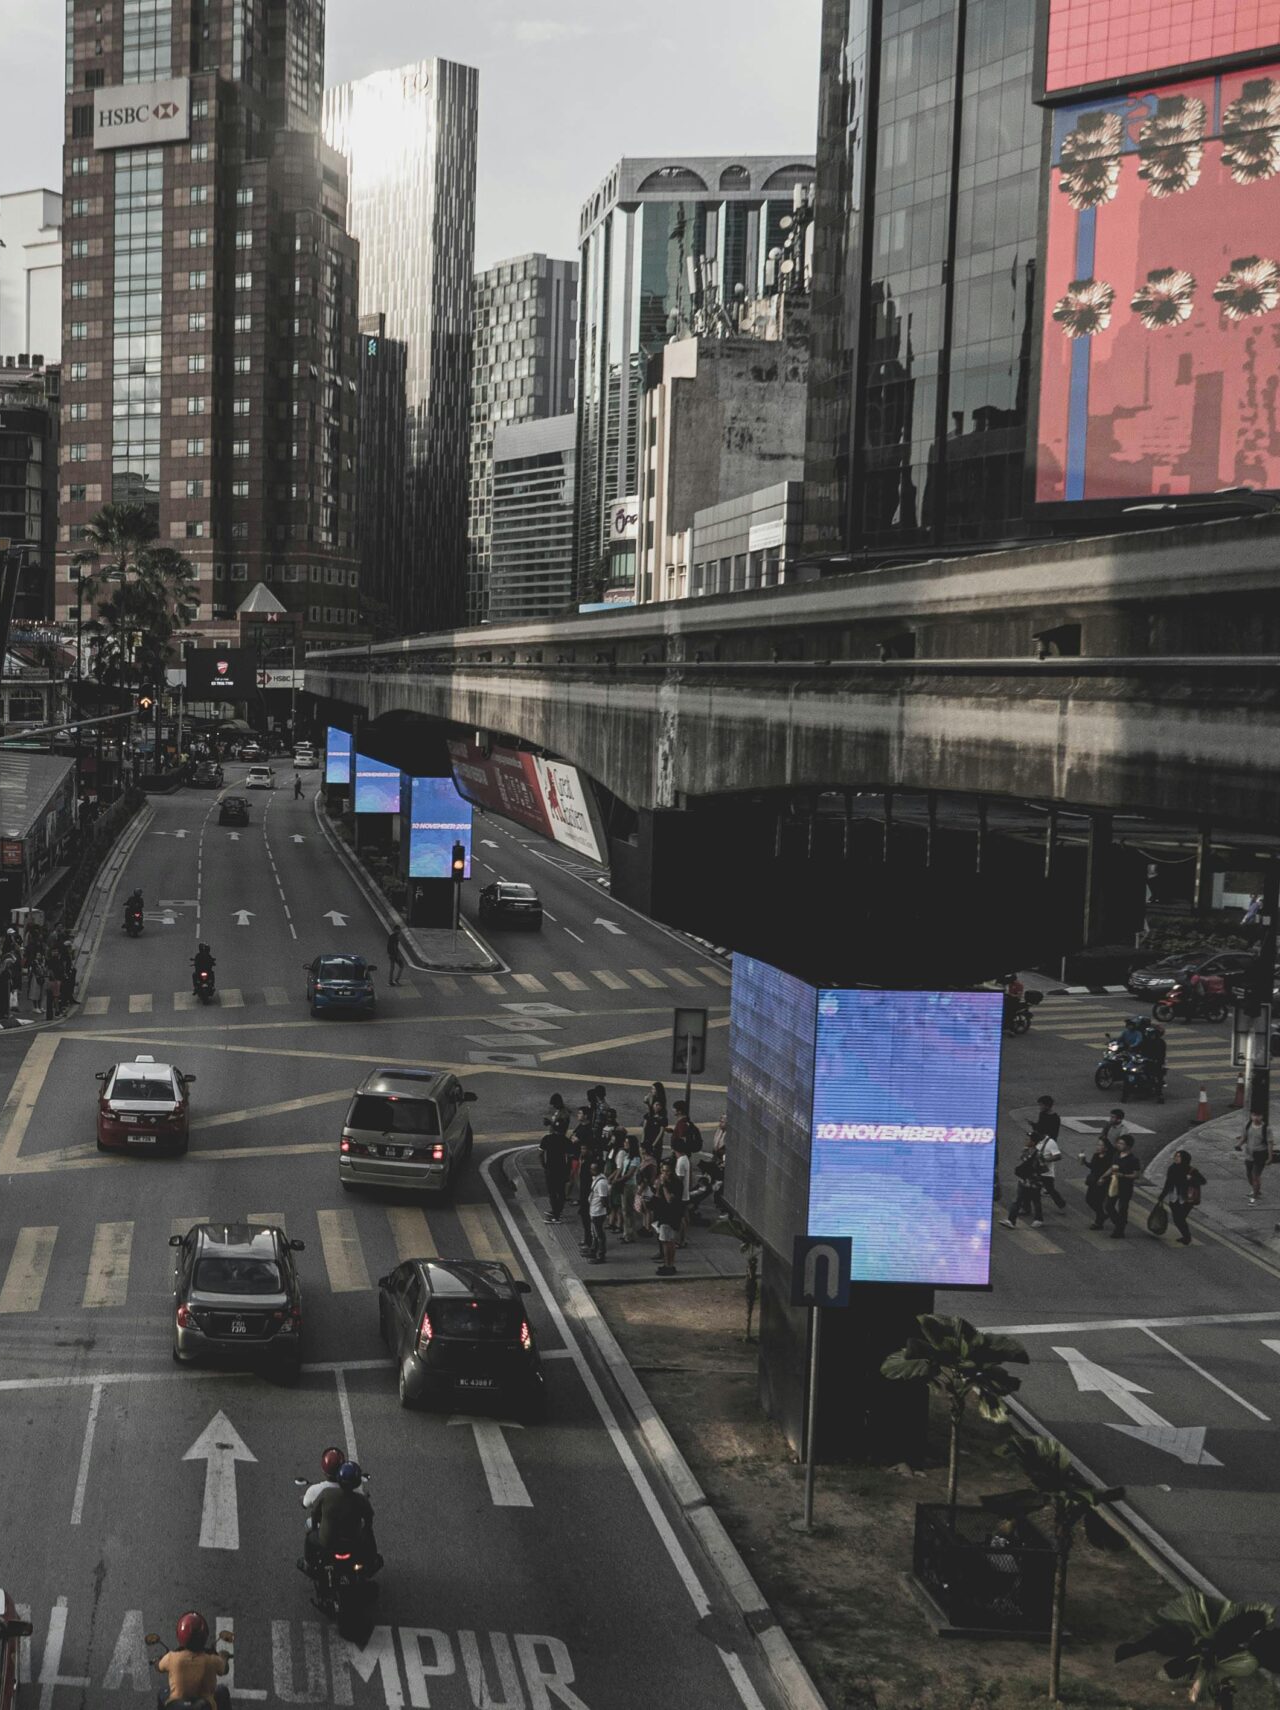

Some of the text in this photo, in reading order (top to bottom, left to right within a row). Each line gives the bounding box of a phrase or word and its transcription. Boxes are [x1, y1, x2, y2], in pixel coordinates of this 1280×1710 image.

[99, 105, 149, 128] HSBC
[815, 1123, 995, 1144] 10 NOVEMBER 2019
[215, 1616, 585, 1710] LUMPUR
